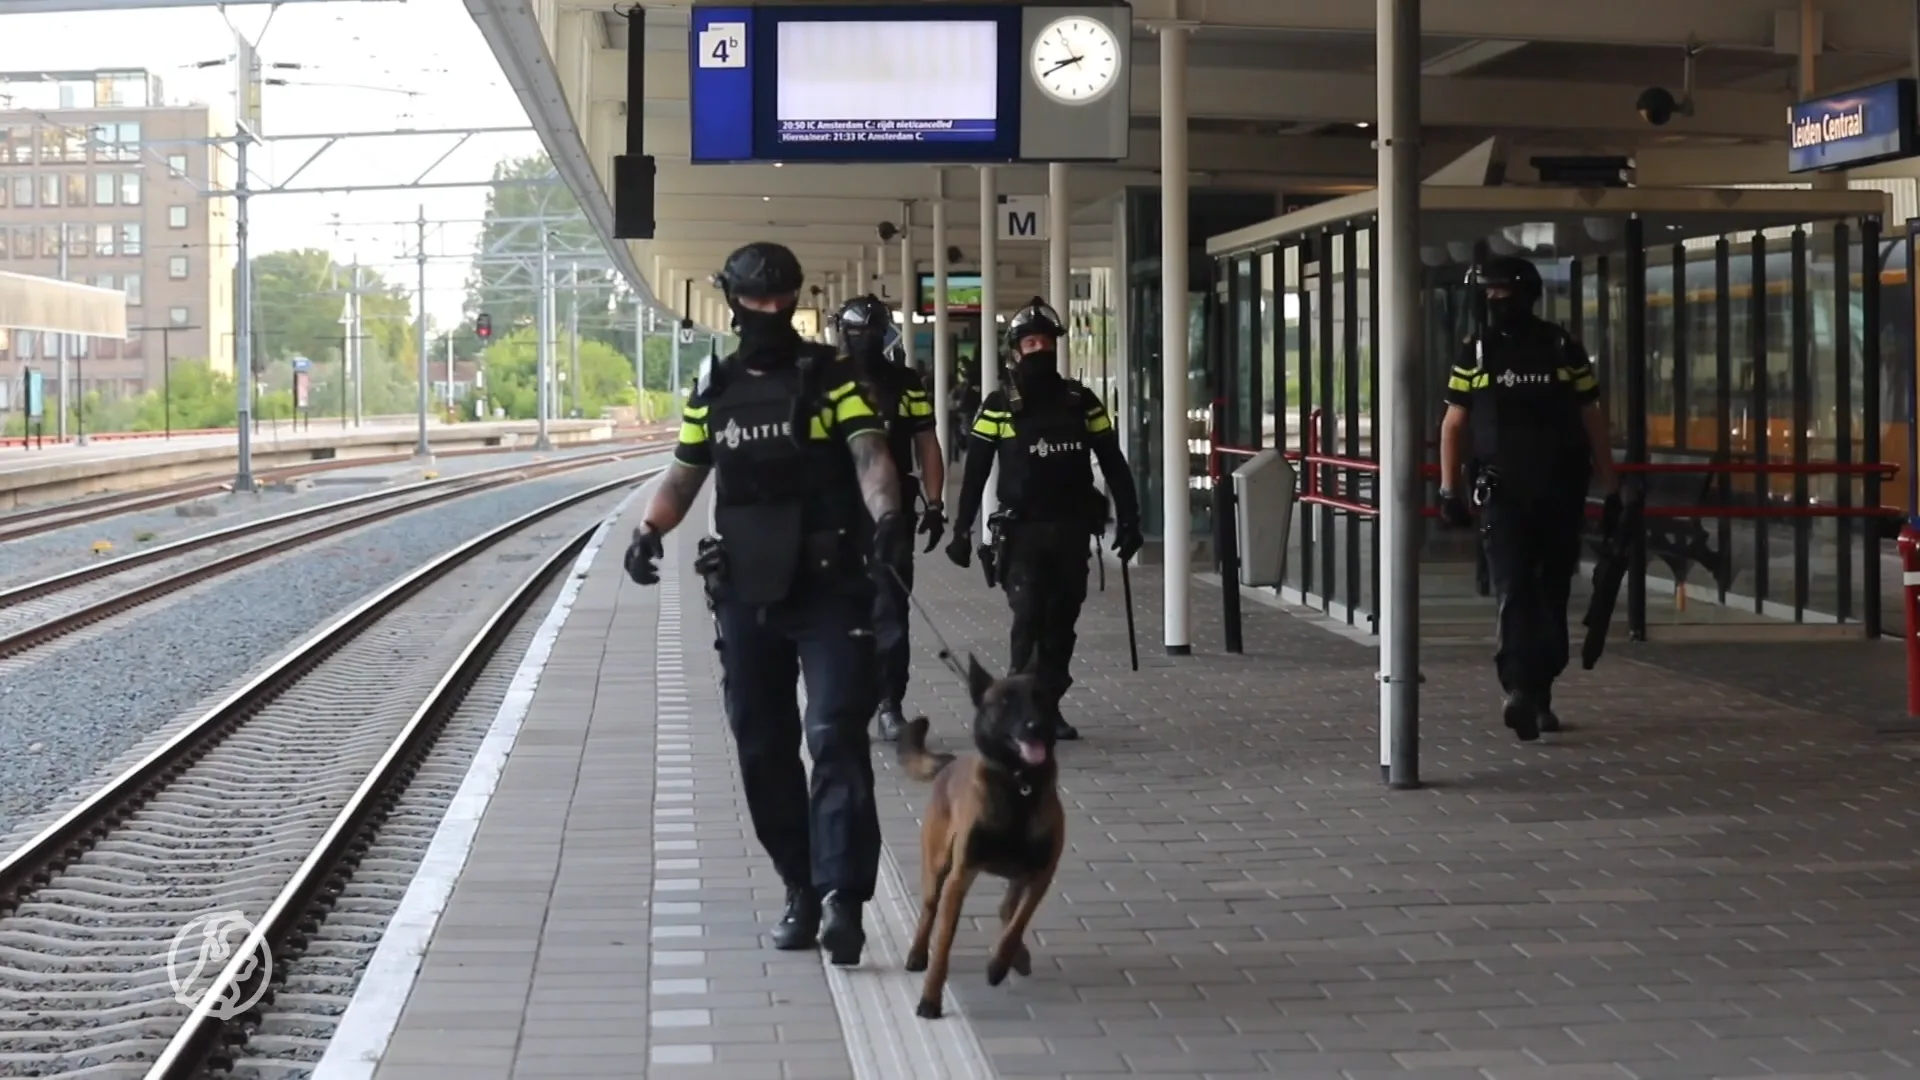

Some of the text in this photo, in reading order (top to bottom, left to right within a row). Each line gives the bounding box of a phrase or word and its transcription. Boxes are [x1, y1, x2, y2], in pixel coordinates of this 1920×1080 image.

[783, 121, 805, 129] 20:50
[807, 121, 815, 129] IC
[817, 121, 863, 129] Amsterdam
[877, 120, 894, 131] rijdt
[1792, 104, 1863, 148] Leiden Centraal
[834, 132, 855, 141] 21:33
[857, 132, 866, 141] IC
[868, 131, 914, 141] Amsterdam
[1009, 211, 1036, 236] M
[881, 284, 890, 298] L
[715, 418, 791, 449] POLITIE
[1029, 437, 1082, 457] POLITIE
